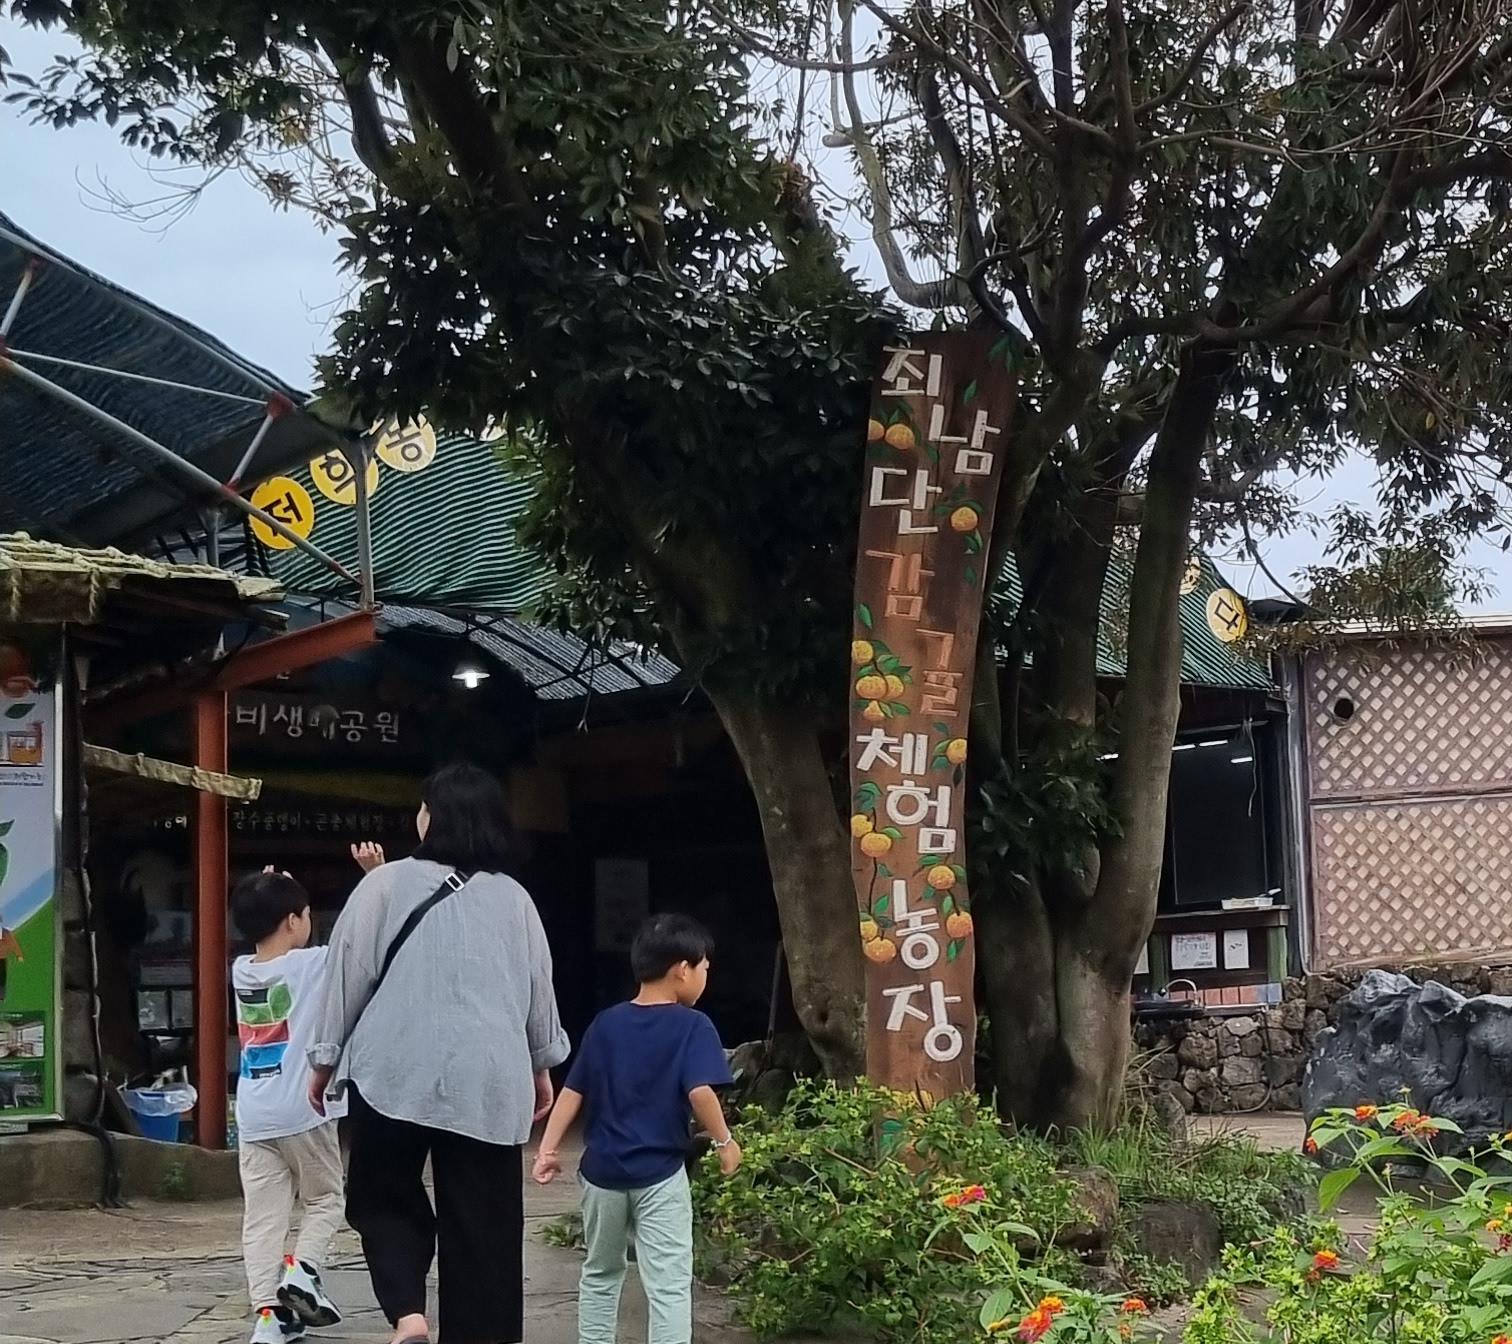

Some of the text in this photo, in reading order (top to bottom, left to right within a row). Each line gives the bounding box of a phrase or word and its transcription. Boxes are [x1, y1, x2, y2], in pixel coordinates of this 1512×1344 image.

[855, 345, 1002, 1063] 최남단 감귤 체험 농장
